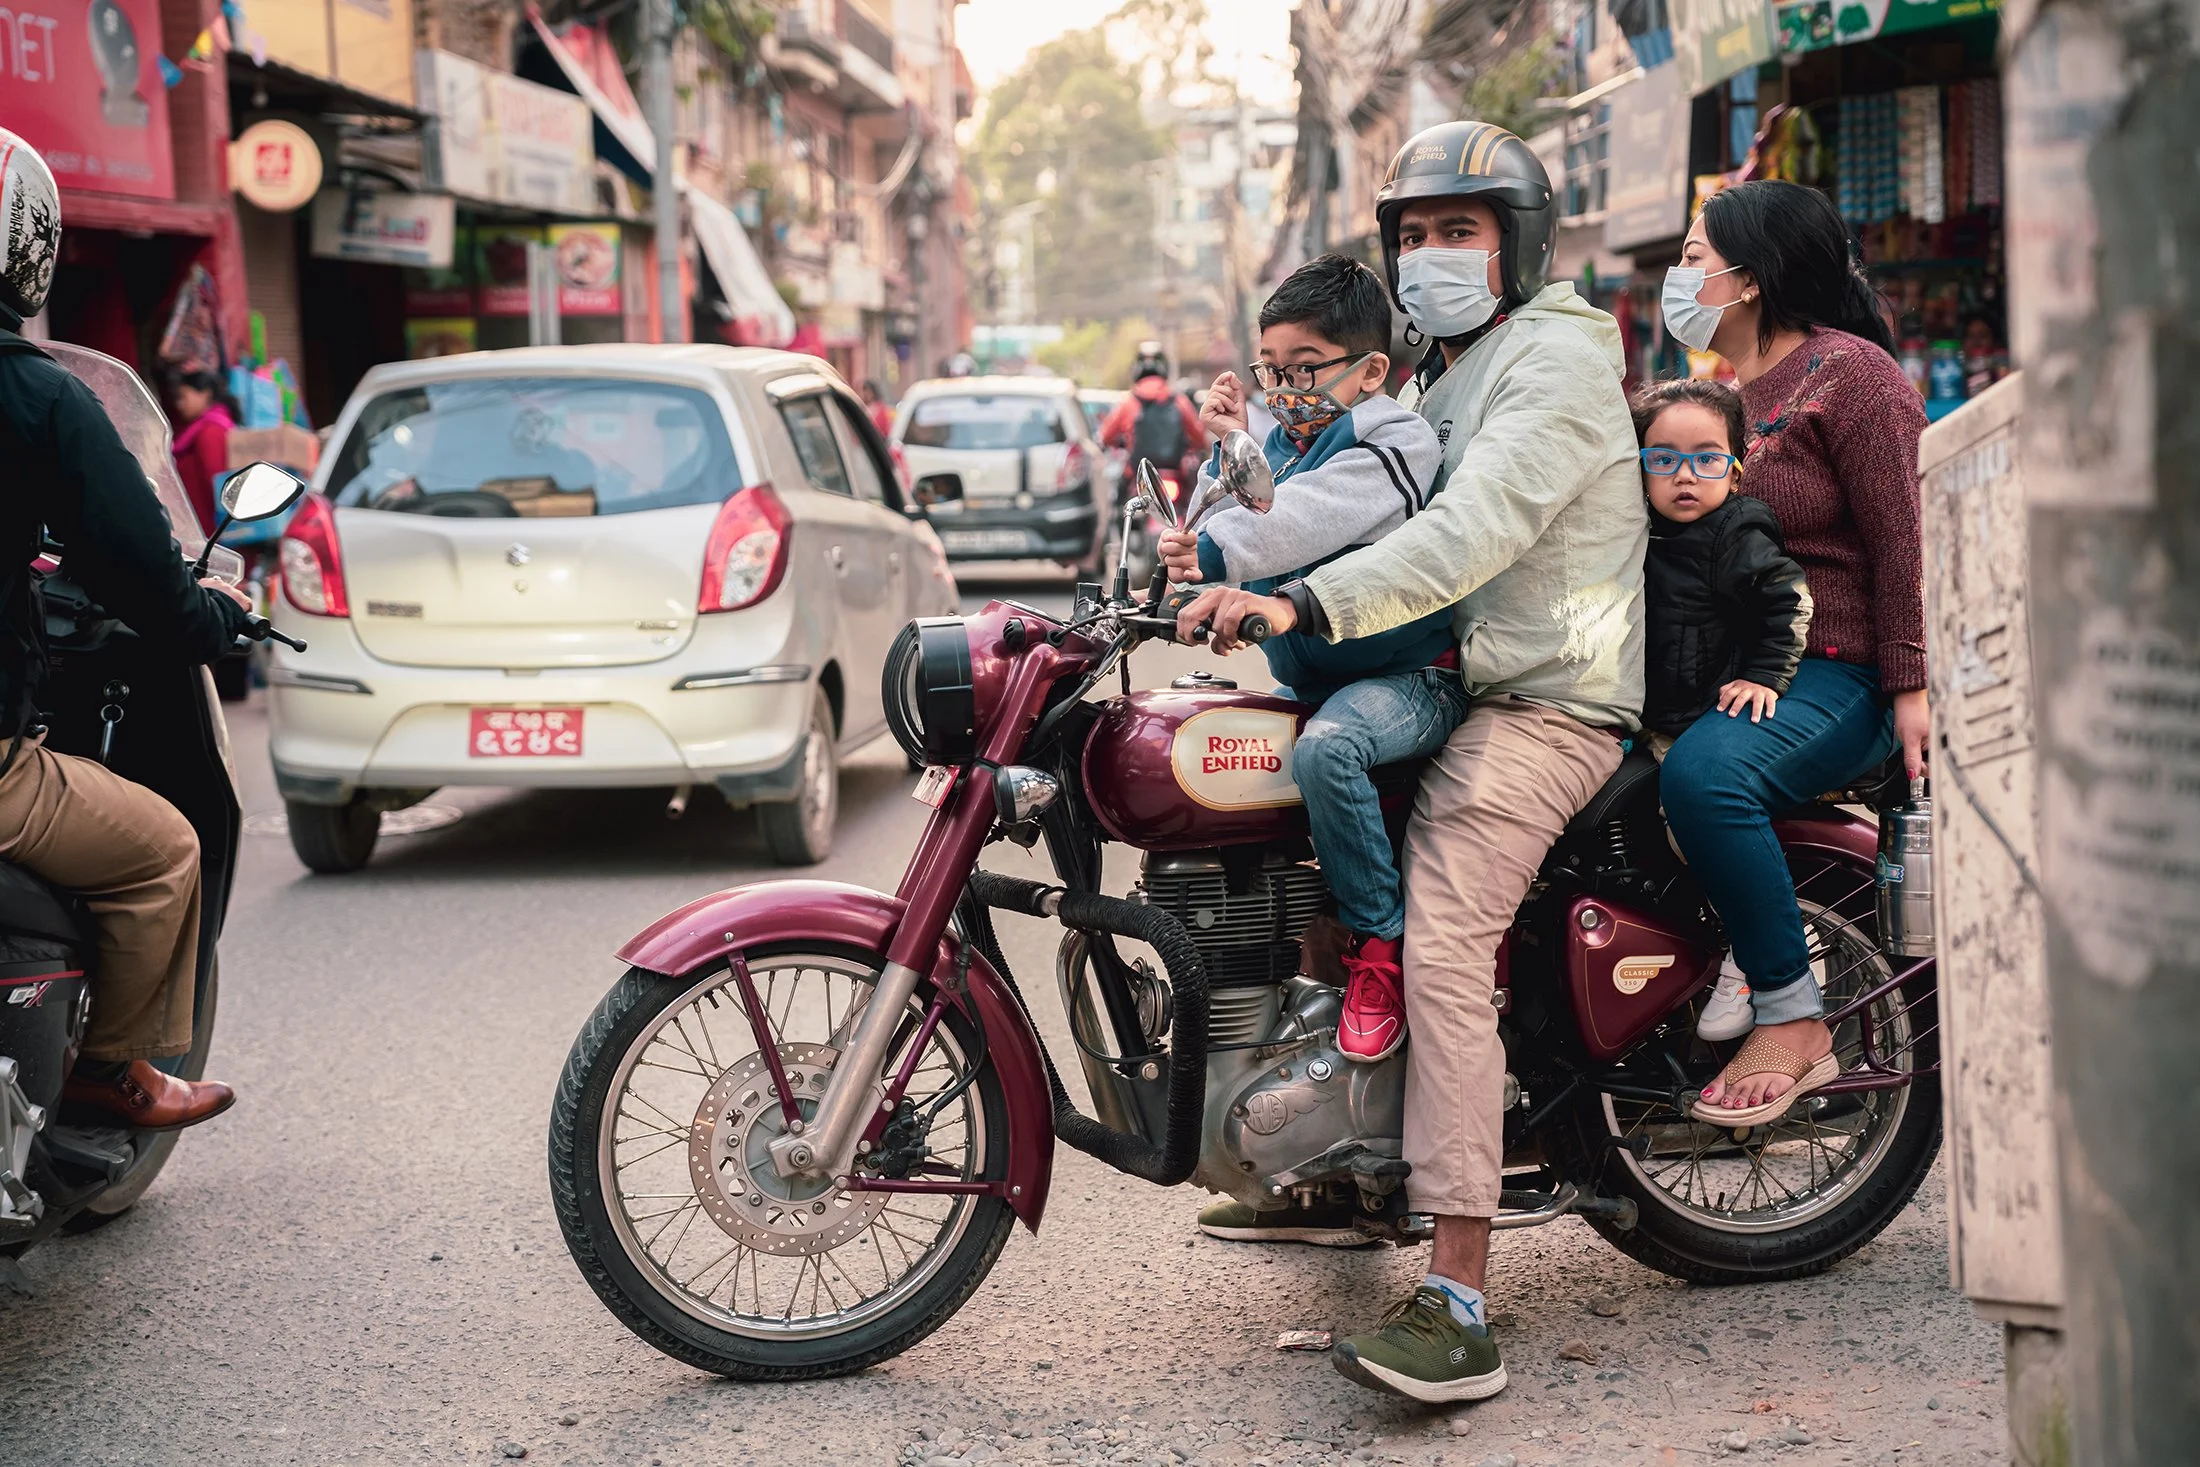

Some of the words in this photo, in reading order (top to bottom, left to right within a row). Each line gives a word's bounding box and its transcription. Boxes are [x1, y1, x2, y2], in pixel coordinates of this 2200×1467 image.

[1410, 152, 1448, 164] ENFIELD
[1415, 145, 1445, 155] ROYAL
[1208, 736, 1273, 754] ROYAL
[1202, 755, 1282, 774] ENFIELD
[671, 1319, 739, 1355] MRF
